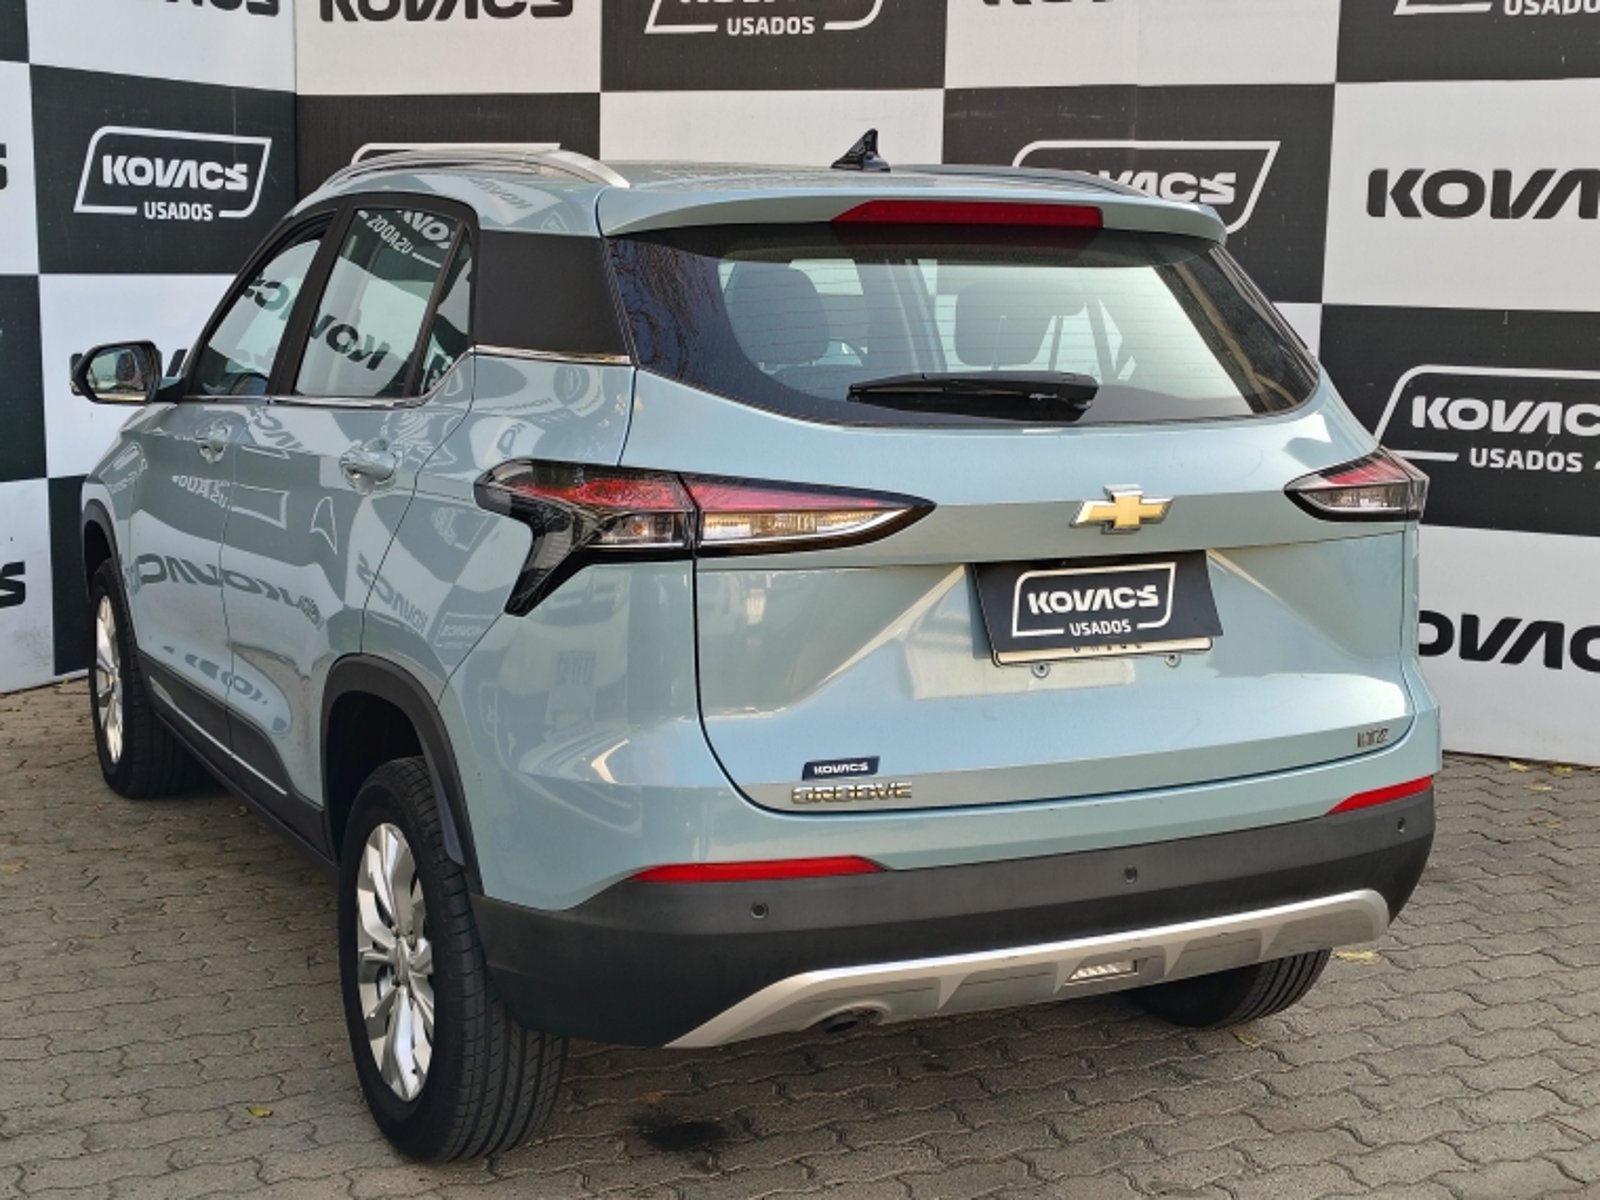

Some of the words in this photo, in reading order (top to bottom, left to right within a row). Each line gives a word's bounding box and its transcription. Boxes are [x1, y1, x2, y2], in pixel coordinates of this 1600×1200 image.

[726, 16, 816, 36] USADOS
[102, 154, 248, 191] KOVACS
[144, 201, 214, 221] USADOS
[1469, 448, 1583, 473] USADOS
[1027, 585, 1160, 615] KOVACS
[1069, 618, 1132, 637] USADOS
[813, 761, 869, 775] KOVACS
[791, 781, 913, 804] GROOVE
